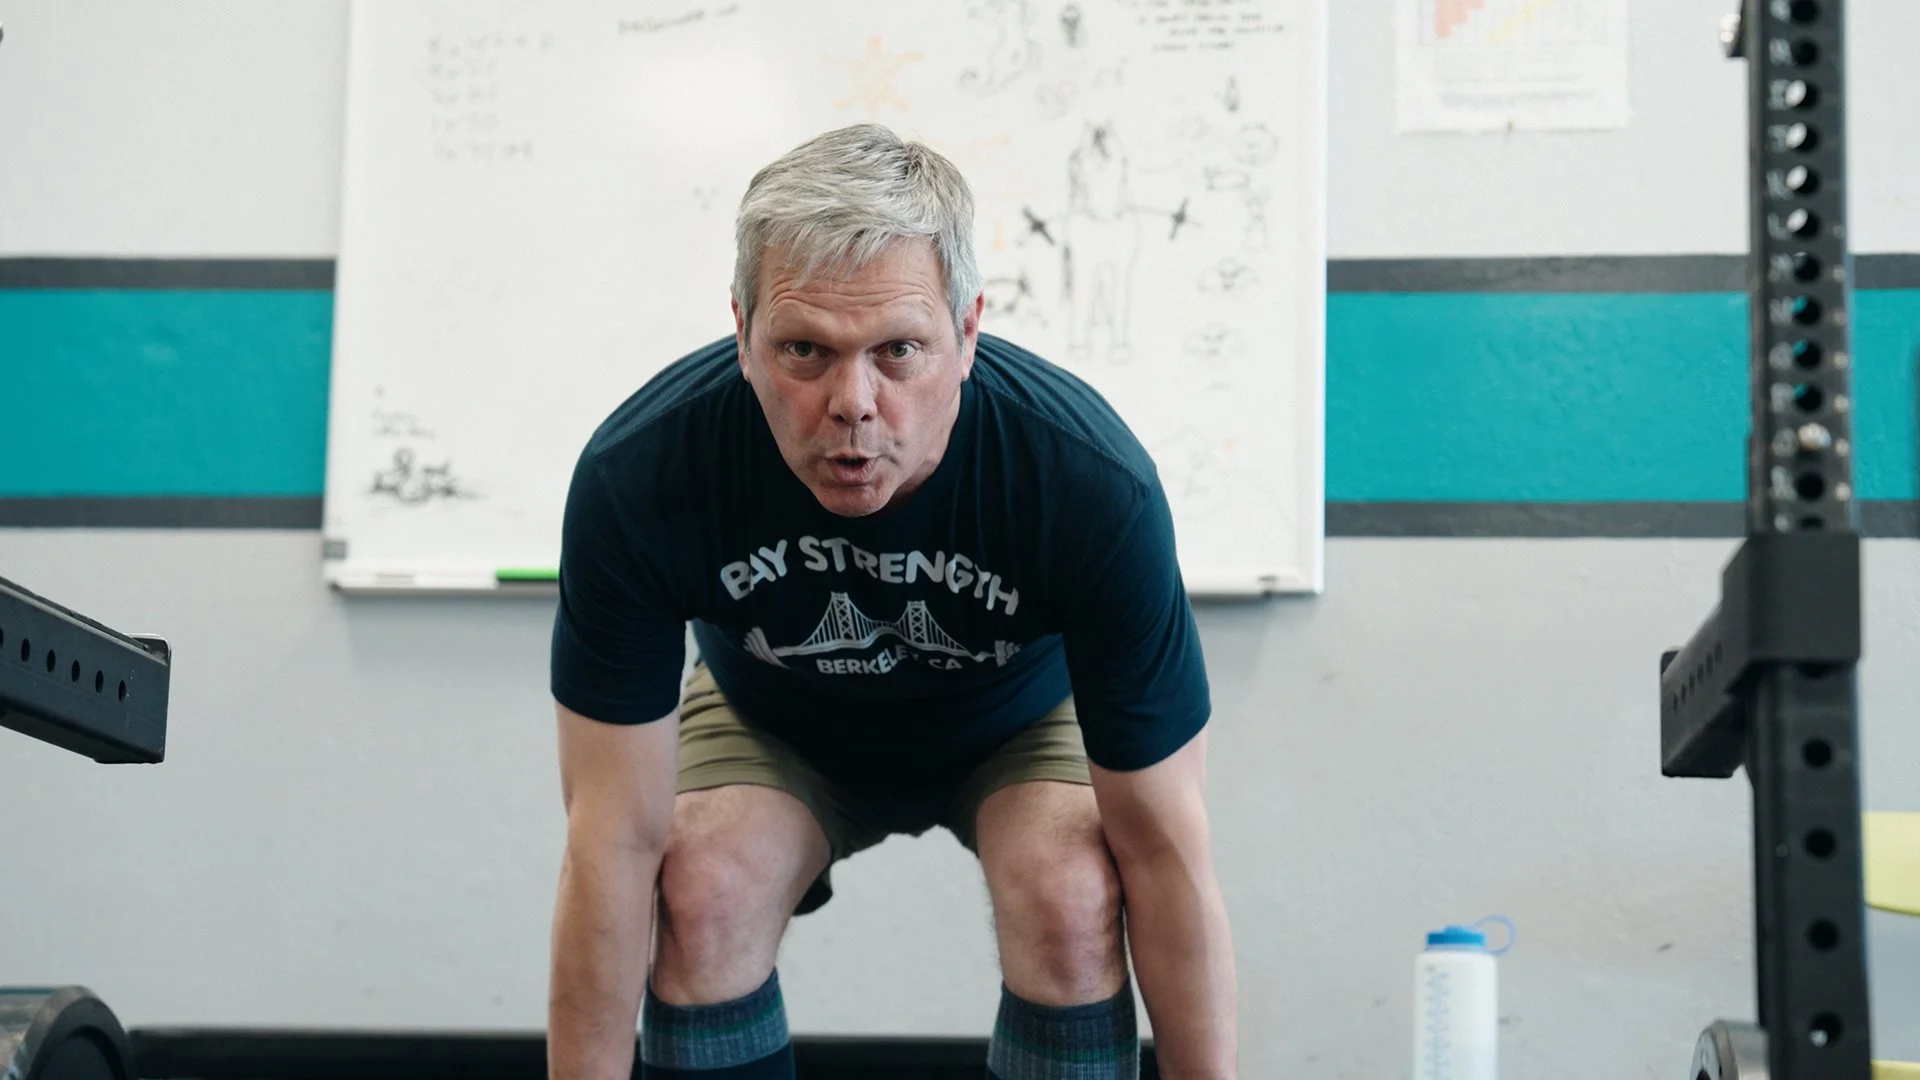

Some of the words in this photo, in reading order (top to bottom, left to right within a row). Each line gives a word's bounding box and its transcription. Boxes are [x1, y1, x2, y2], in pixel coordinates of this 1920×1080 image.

[720, 539, 788, 601] BAY
[798, 535, 1019, 616] STRENGTH
[928, 658, 963, 670] CA
